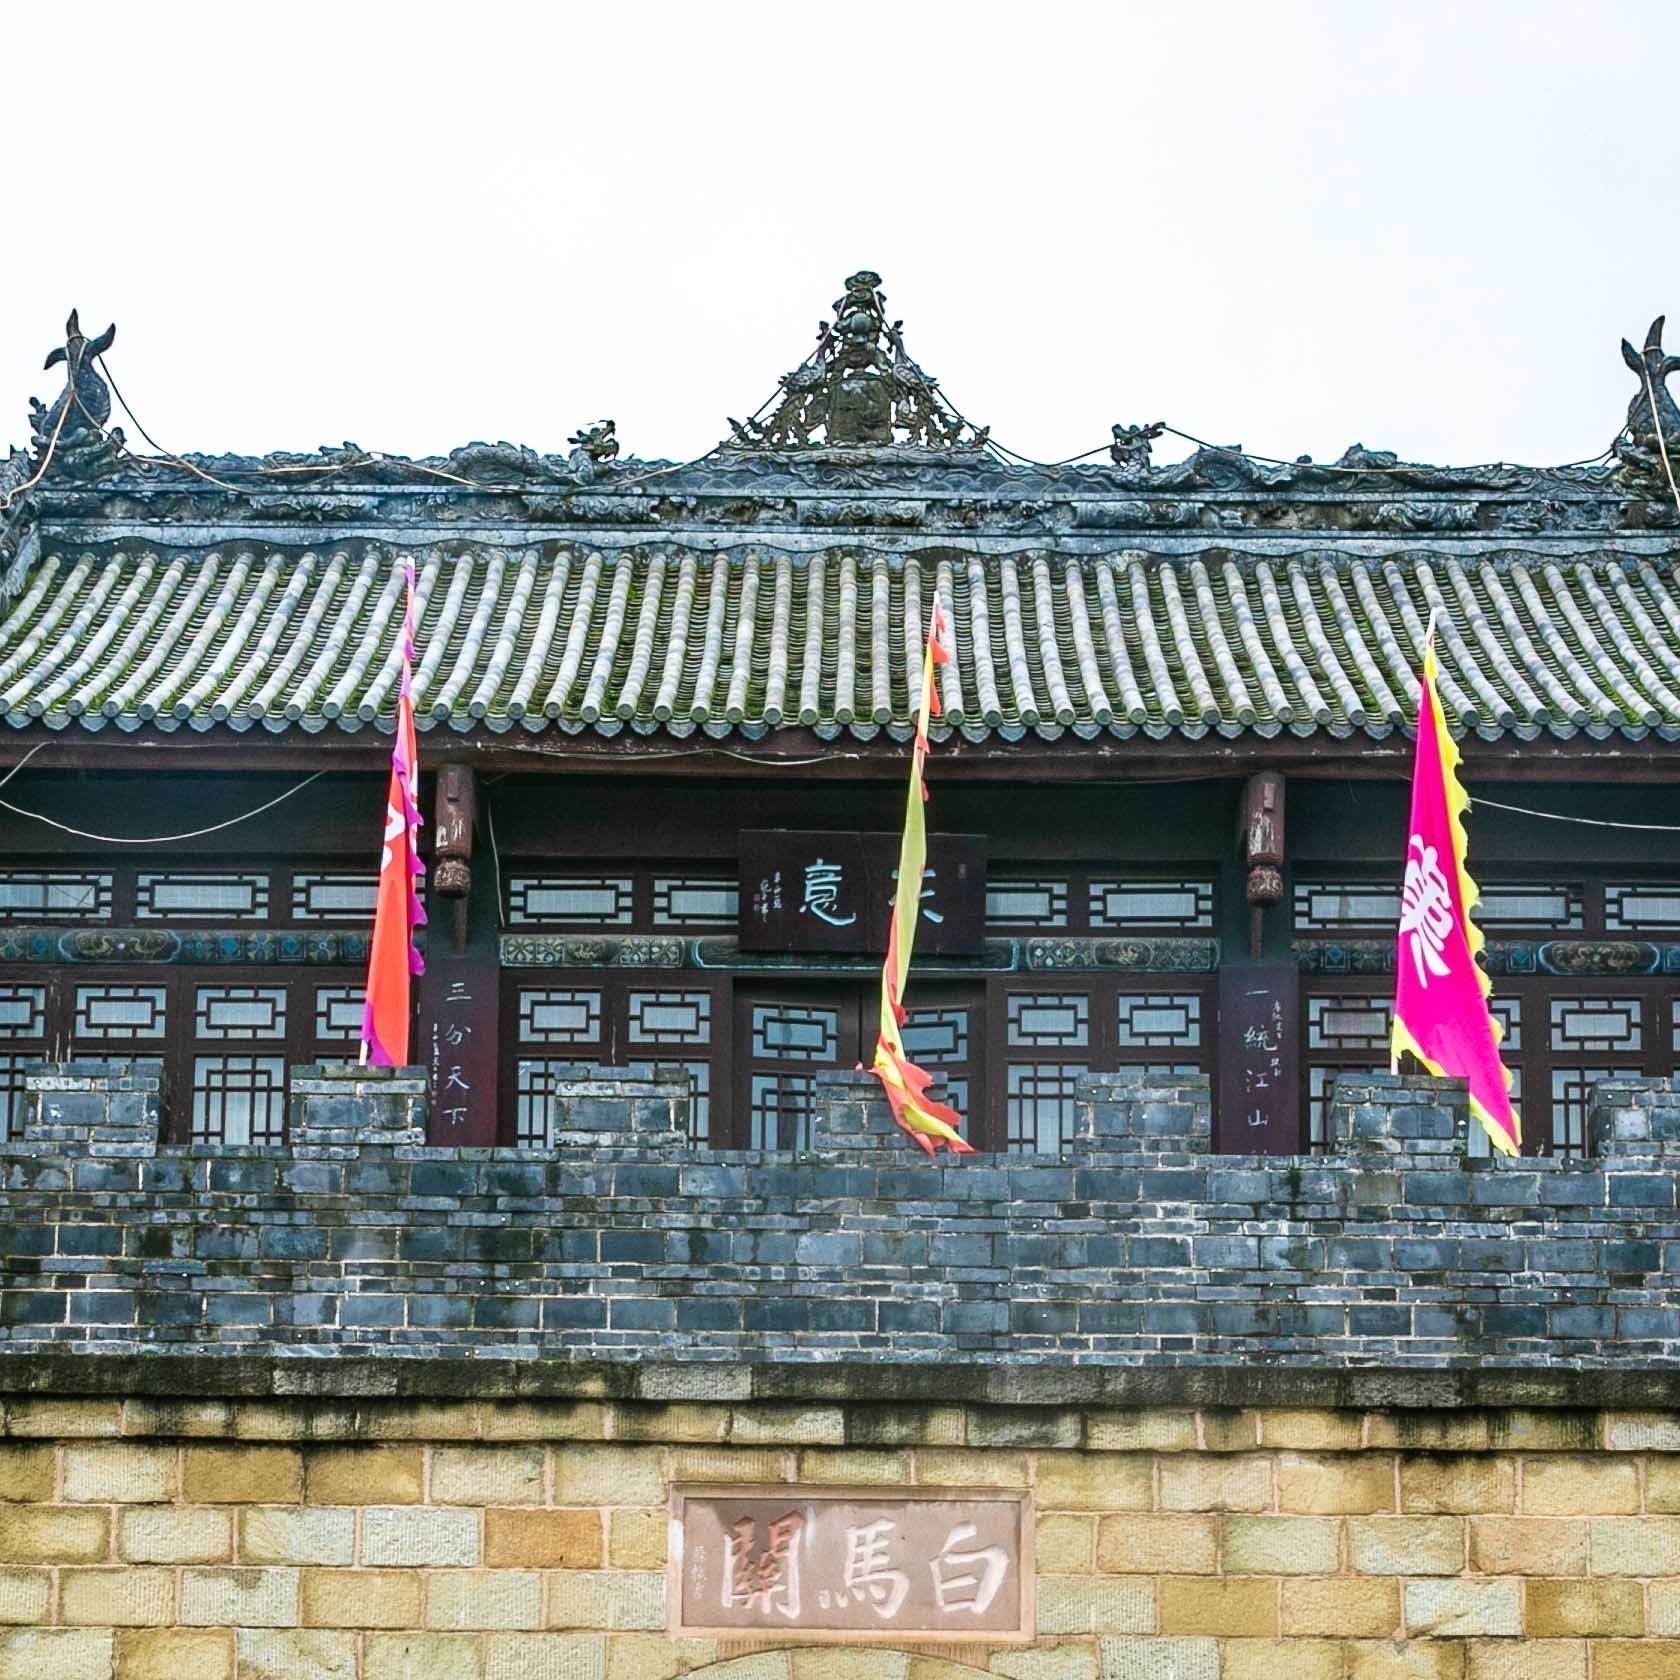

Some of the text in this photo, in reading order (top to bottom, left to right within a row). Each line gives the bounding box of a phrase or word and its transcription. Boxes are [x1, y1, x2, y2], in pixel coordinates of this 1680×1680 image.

[442, 982, 473, 1125] 三分天下
[1243, 989, 1279, 1154] 一統江山
